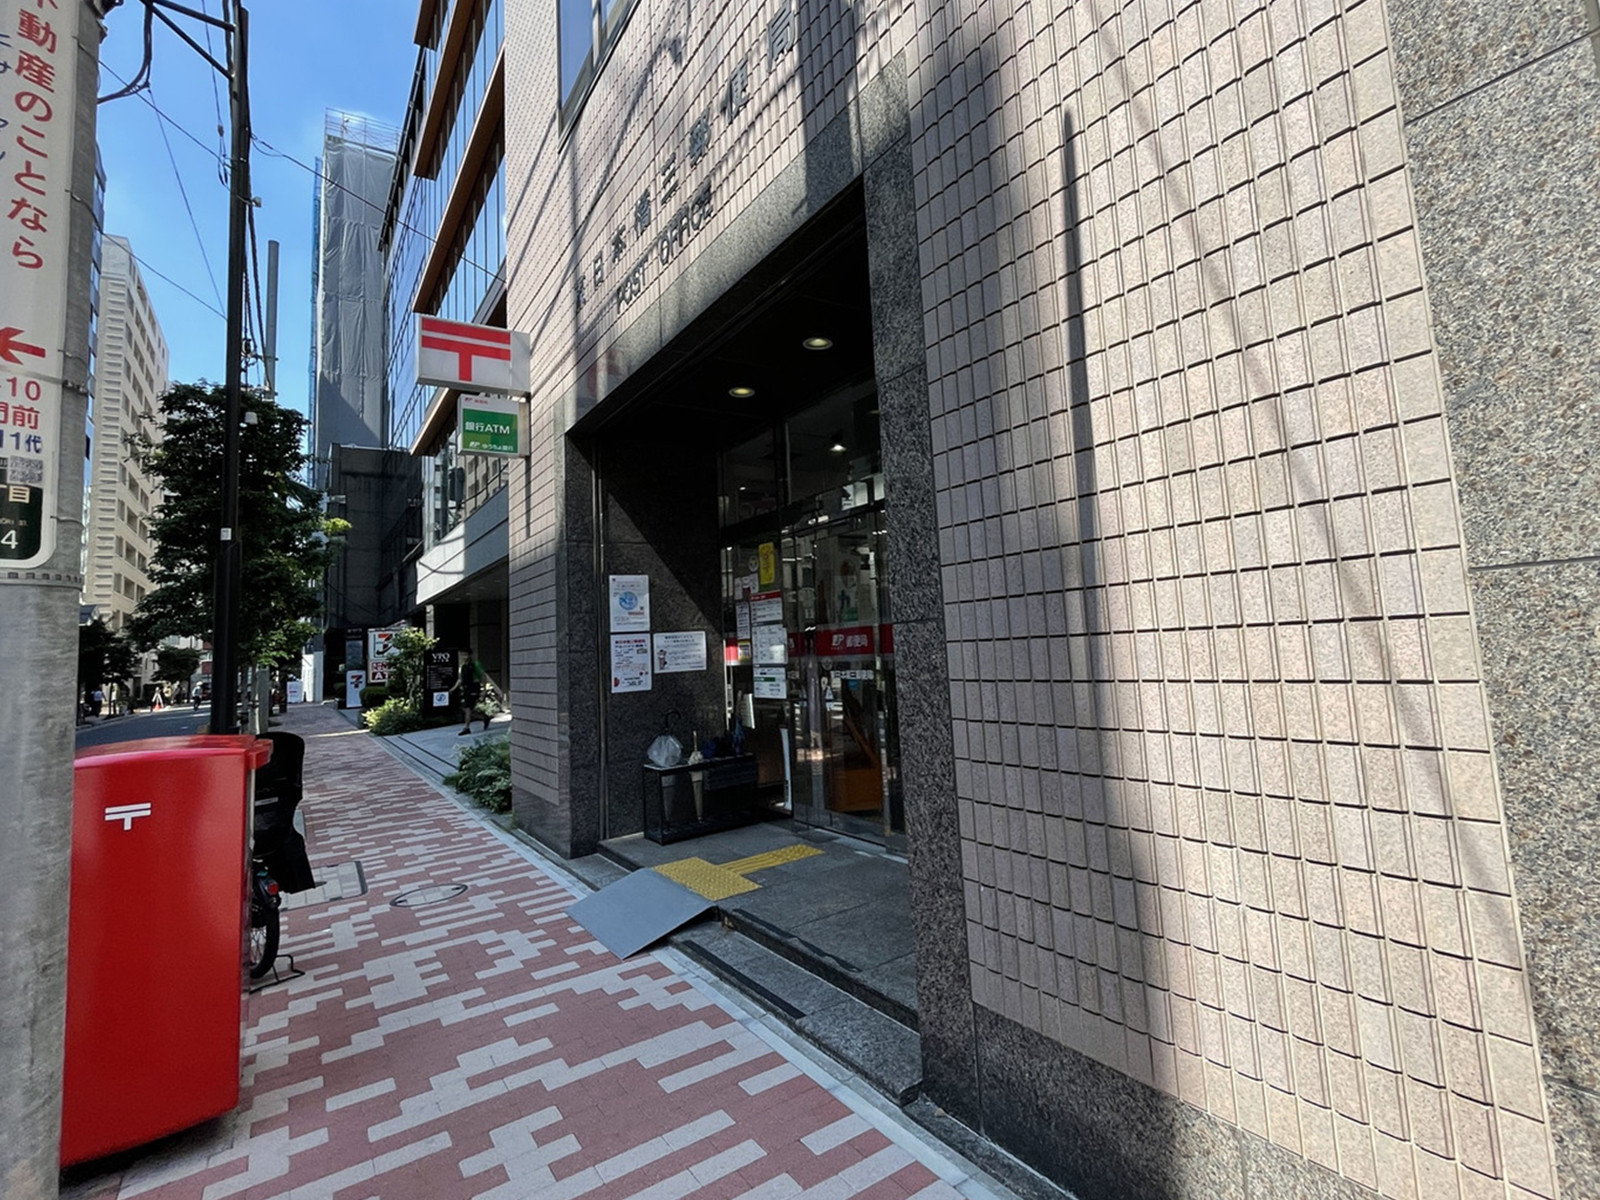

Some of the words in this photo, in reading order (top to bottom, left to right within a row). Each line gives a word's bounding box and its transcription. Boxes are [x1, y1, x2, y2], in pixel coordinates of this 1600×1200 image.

[616, 256, 650, 314] POST
[657, 183, 714, 266] OFFICE
[465, 421, 510, 435] 銀行ATM
